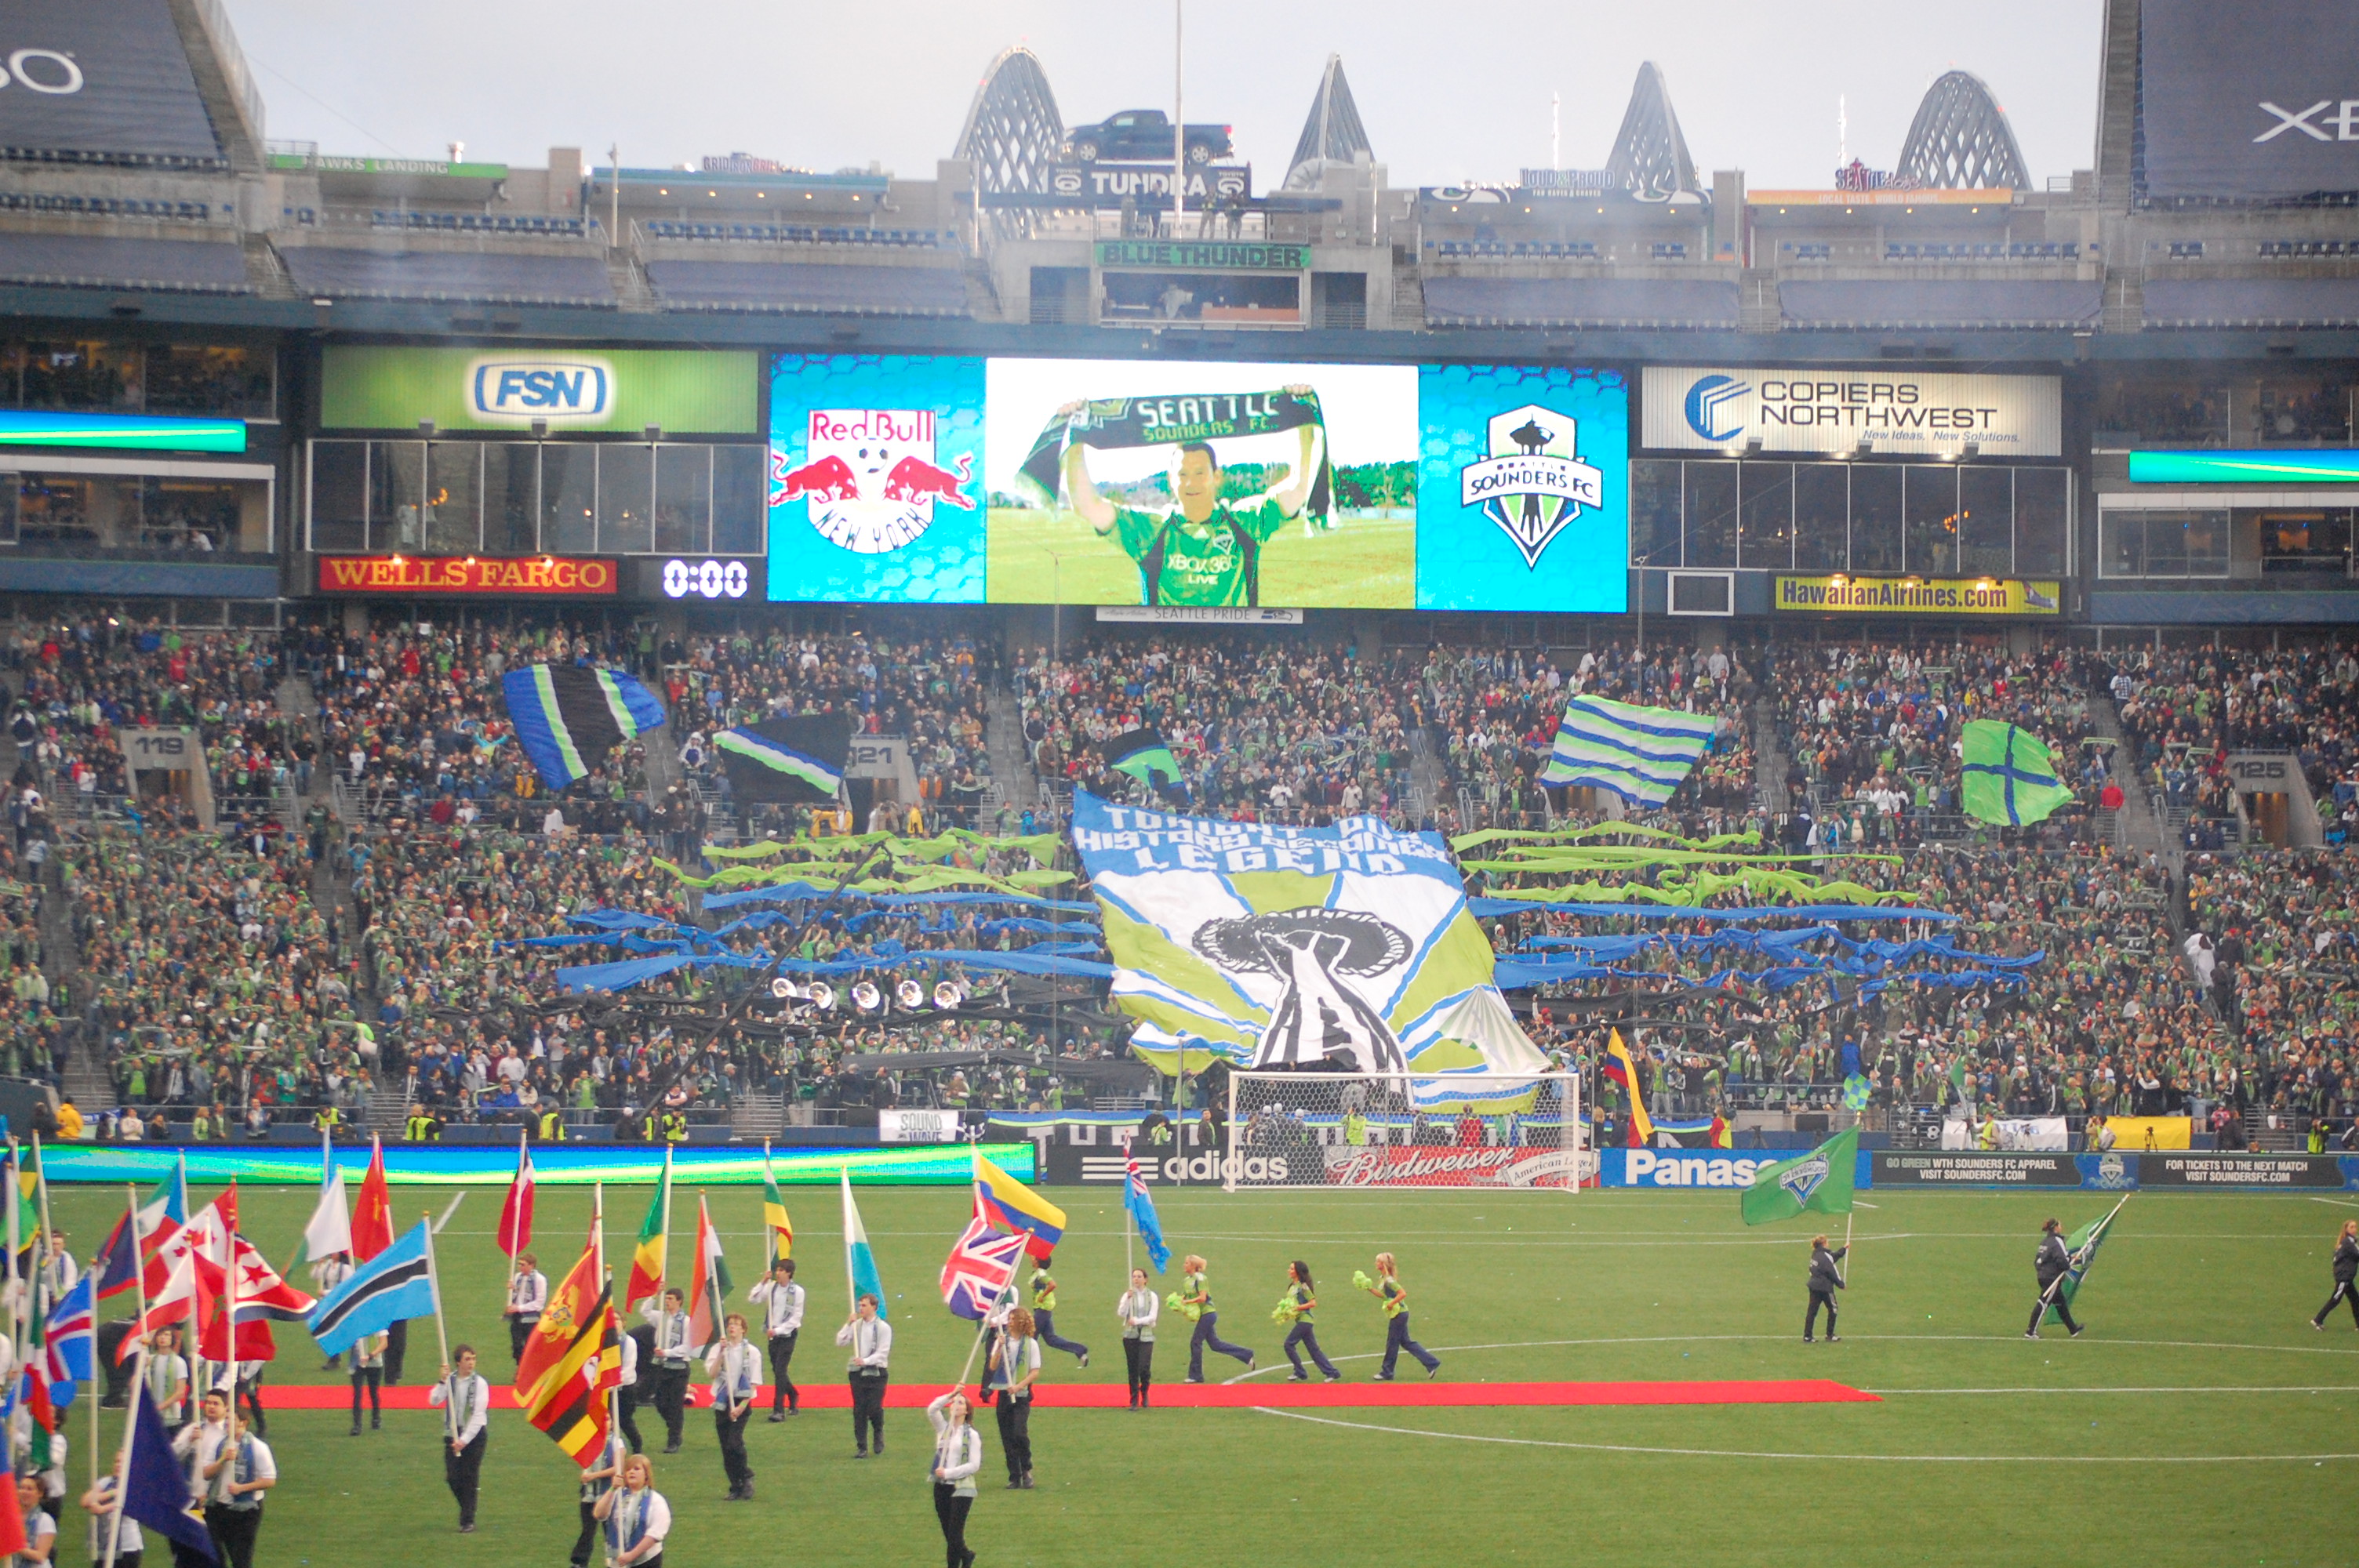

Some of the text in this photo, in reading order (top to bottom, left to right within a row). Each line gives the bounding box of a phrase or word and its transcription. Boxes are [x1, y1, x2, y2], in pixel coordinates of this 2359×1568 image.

[376, 159, 448, 174] LANDING
[1091, 172, 1207, 196] TUNDRA
[1104, 245, 1301, 267] BLUE THUNDER
[496, 371, 584, 407] FSN
[1761, 381, 1919, 404] COPIERS
[812, 410, 931, 442] Red Bull
[1761, 405, 1997, 429] NORTHWEST
[1143, 419, 1235, 442] SOUNDERS
[1863, 430, 2020, 443] New Ideas. New Solutions.
[1471, 470, 1593, 498] SOUNDERS FC
[331, 561, 607, 589] WELLS FARGO
[663, 559, 747, 598] 0:00
[1188, 574, 1219, 585] LIVE
[1783, 580, 2007, 608] HawaiianAirlines.com
[1155, 608, 1208, 619] SEATTLE
[1213, 608, 1251, 620] PRIDE
[136, 737, 184, 754] 119
[2232, 761, 2285, 779] 125
[1074, 826, 1251, 851] HISTORY
[1135, 844, 1406, 874] LEGEND
[901, 1113, 941, 1131] SOUND
[1164, 1150, 1289, 1180] adidas
[1332, 1147, 1514, 1185] Budweiser
[1514, 1159, 1561, 1181] American
[1886, 1158, 1899, 1168] GO
[1901, 1158, 1931, 1168] GREEN
[1955, 1159, 2004, 1169] SOUNDERS
[2005, 1160, 2016, 1169] FC
[2018, 1160, 2057, 1170] APPAREL
[1920, 1169, 2026, 1181] VISIT SOUNDERSFC.COM
[2166, 1160, 2308, 1171] FOR TICKETS TO THE NEXT MATCH
[2186, 1171, 2291, 1182] VISIT SOUNDERSFC.COM
